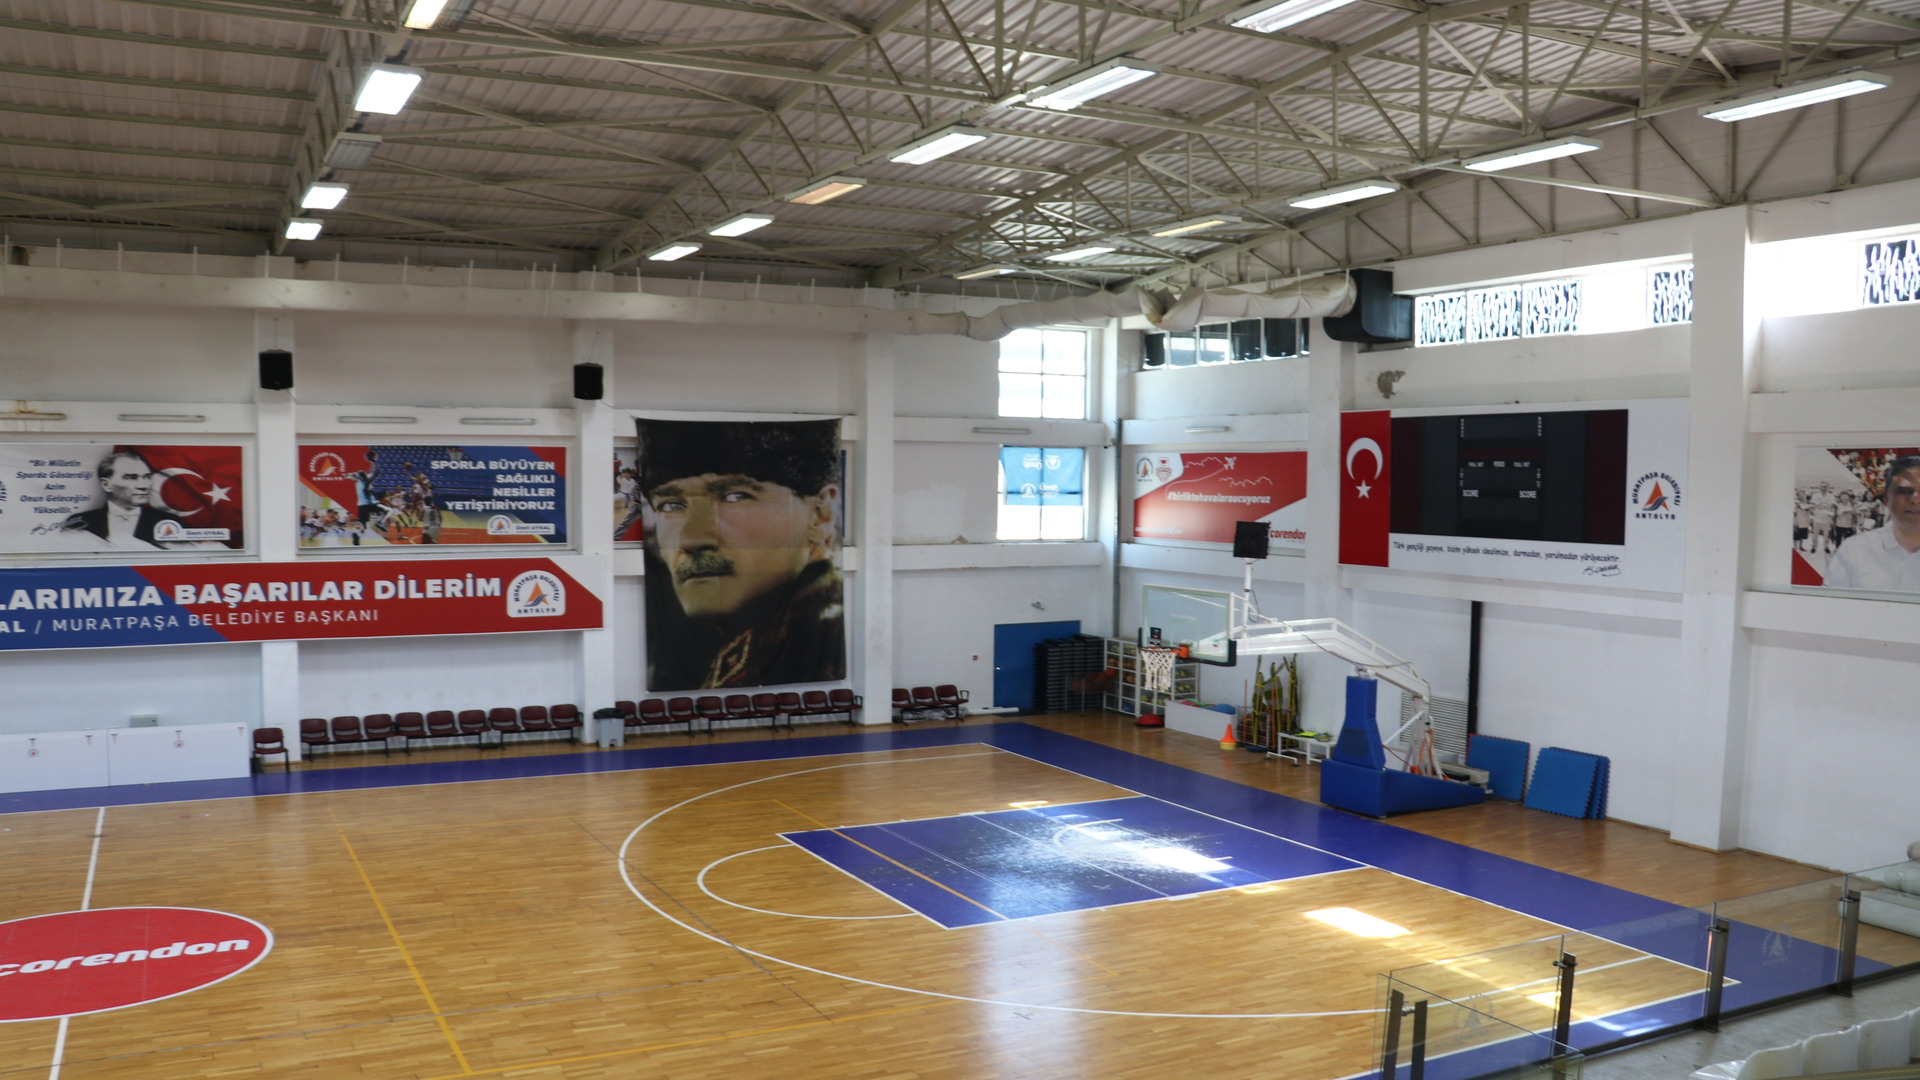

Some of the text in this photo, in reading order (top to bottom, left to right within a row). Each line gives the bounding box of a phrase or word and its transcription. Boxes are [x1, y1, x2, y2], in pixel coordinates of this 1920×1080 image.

[430, 458, 555, 470] SPORLA BÜYÜYEN
[496, 472, 555, 483] SAĞLIKLI
[492, 486, 556, 496] NESİLLER
[1462, 489, 1479, 497] SCORE
[1519, 490, 1537, 498] SCORE
[445, 499, 556, 512] YETİŞTİRİYORUZ
[1635, 512, 1676, 520] ANTALYA
[174, 579, 363, 608] BAŞARILAR
[374, 573, 502, 600] DİLERİM
[52, 615, 179, 632] MURATPAŞA
[188, 608, 285, 627] BELEDİYE
[294, 608, 379, 625] BAŞKANI
